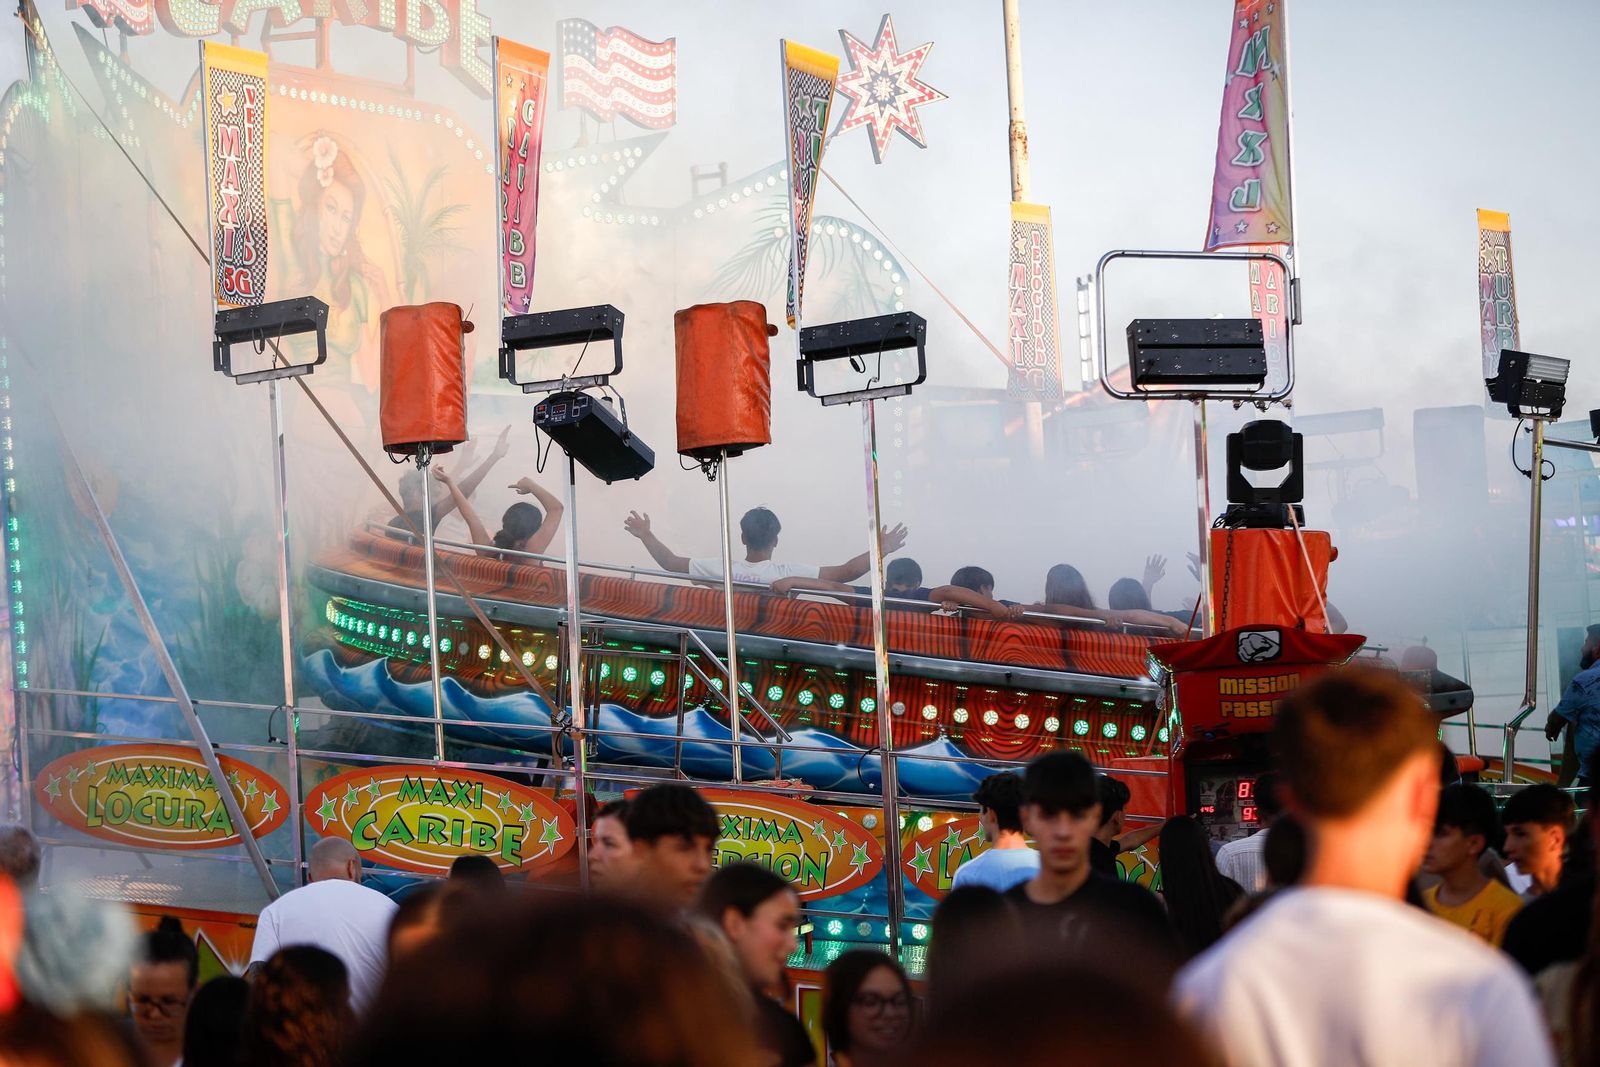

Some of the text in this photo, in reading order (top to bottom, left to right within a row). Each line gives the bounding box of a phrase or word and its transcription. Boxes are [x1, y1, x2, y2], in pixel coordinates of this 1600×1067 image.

[217, 122, 241, 262] MAXI
[223, 264, 255, 299] 5G
[1031, 230, 1048, 367] VELOCIDAD
[1009, 262, 1029, 367] MAXI
[104, 762, 222, 792] MAXIMA
[397, 775, 484, 810] MAXI
[86, 785, 235, 838] LOCURA
[351, 811, 524, 868] CARIBE
